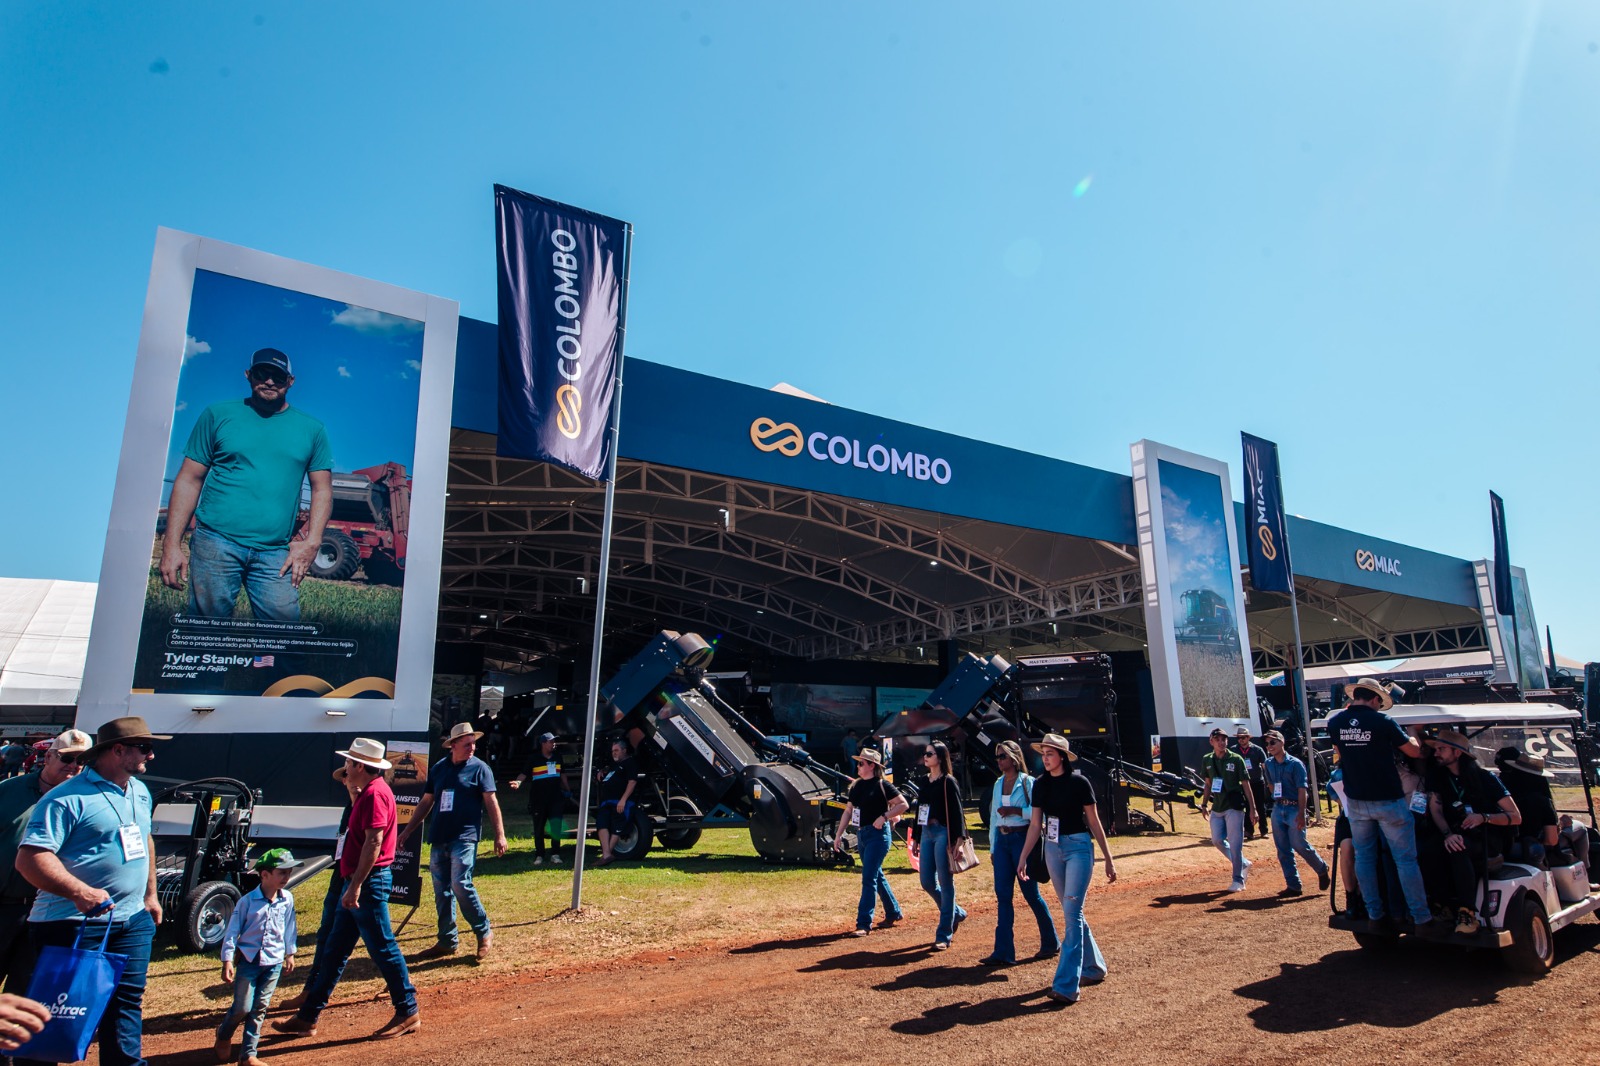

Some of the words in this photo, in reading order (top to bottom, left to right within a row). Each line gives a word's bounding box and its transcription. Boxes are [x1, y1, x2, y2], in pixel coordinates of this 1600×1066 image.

[551, 228, 581, 382] COLOMBO
[807, 431, 952, 485] COLOMBO
[1257, 468, 1269, 524] MIAC
[1373, 554, 1402, 577] MIAC
[194, 640, 238, 648] proporcionado
[164, 652, 200, 664] Tyler
[202, 654, 252, 667] Stanley
[1340, 732, 1372, 740] RIBEIRÃO
[394, 794, 420, 804] RANSFER
[392, 884, 408, 894] MIAC
[41, 1002, 87, 1016] ebtrac
